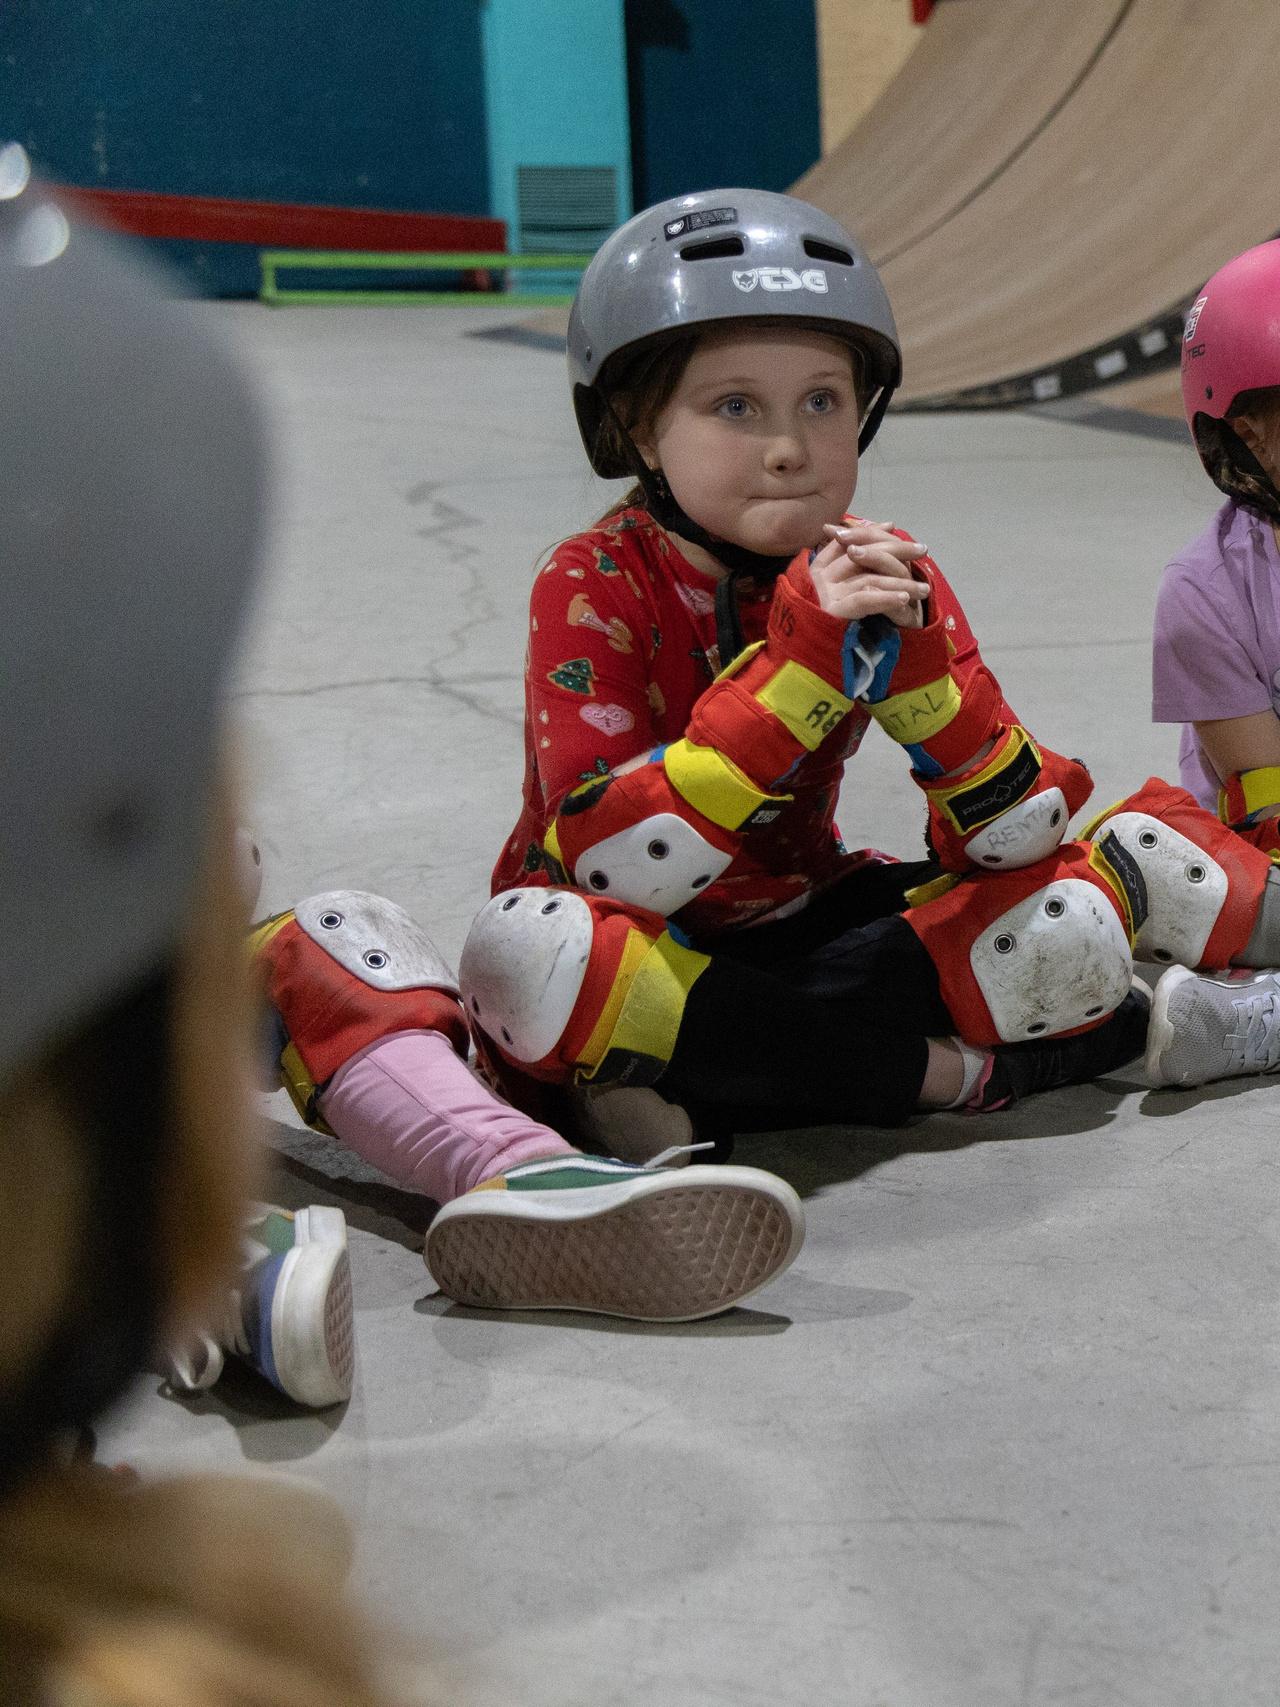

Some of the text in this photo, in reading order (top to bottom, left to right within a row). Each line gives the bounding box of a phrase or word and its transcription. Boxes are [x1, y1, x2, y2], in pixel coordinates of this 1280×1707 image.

[757, 266, 829, 294] TSG
[962, 760, 1032, 817] PRO TEC
